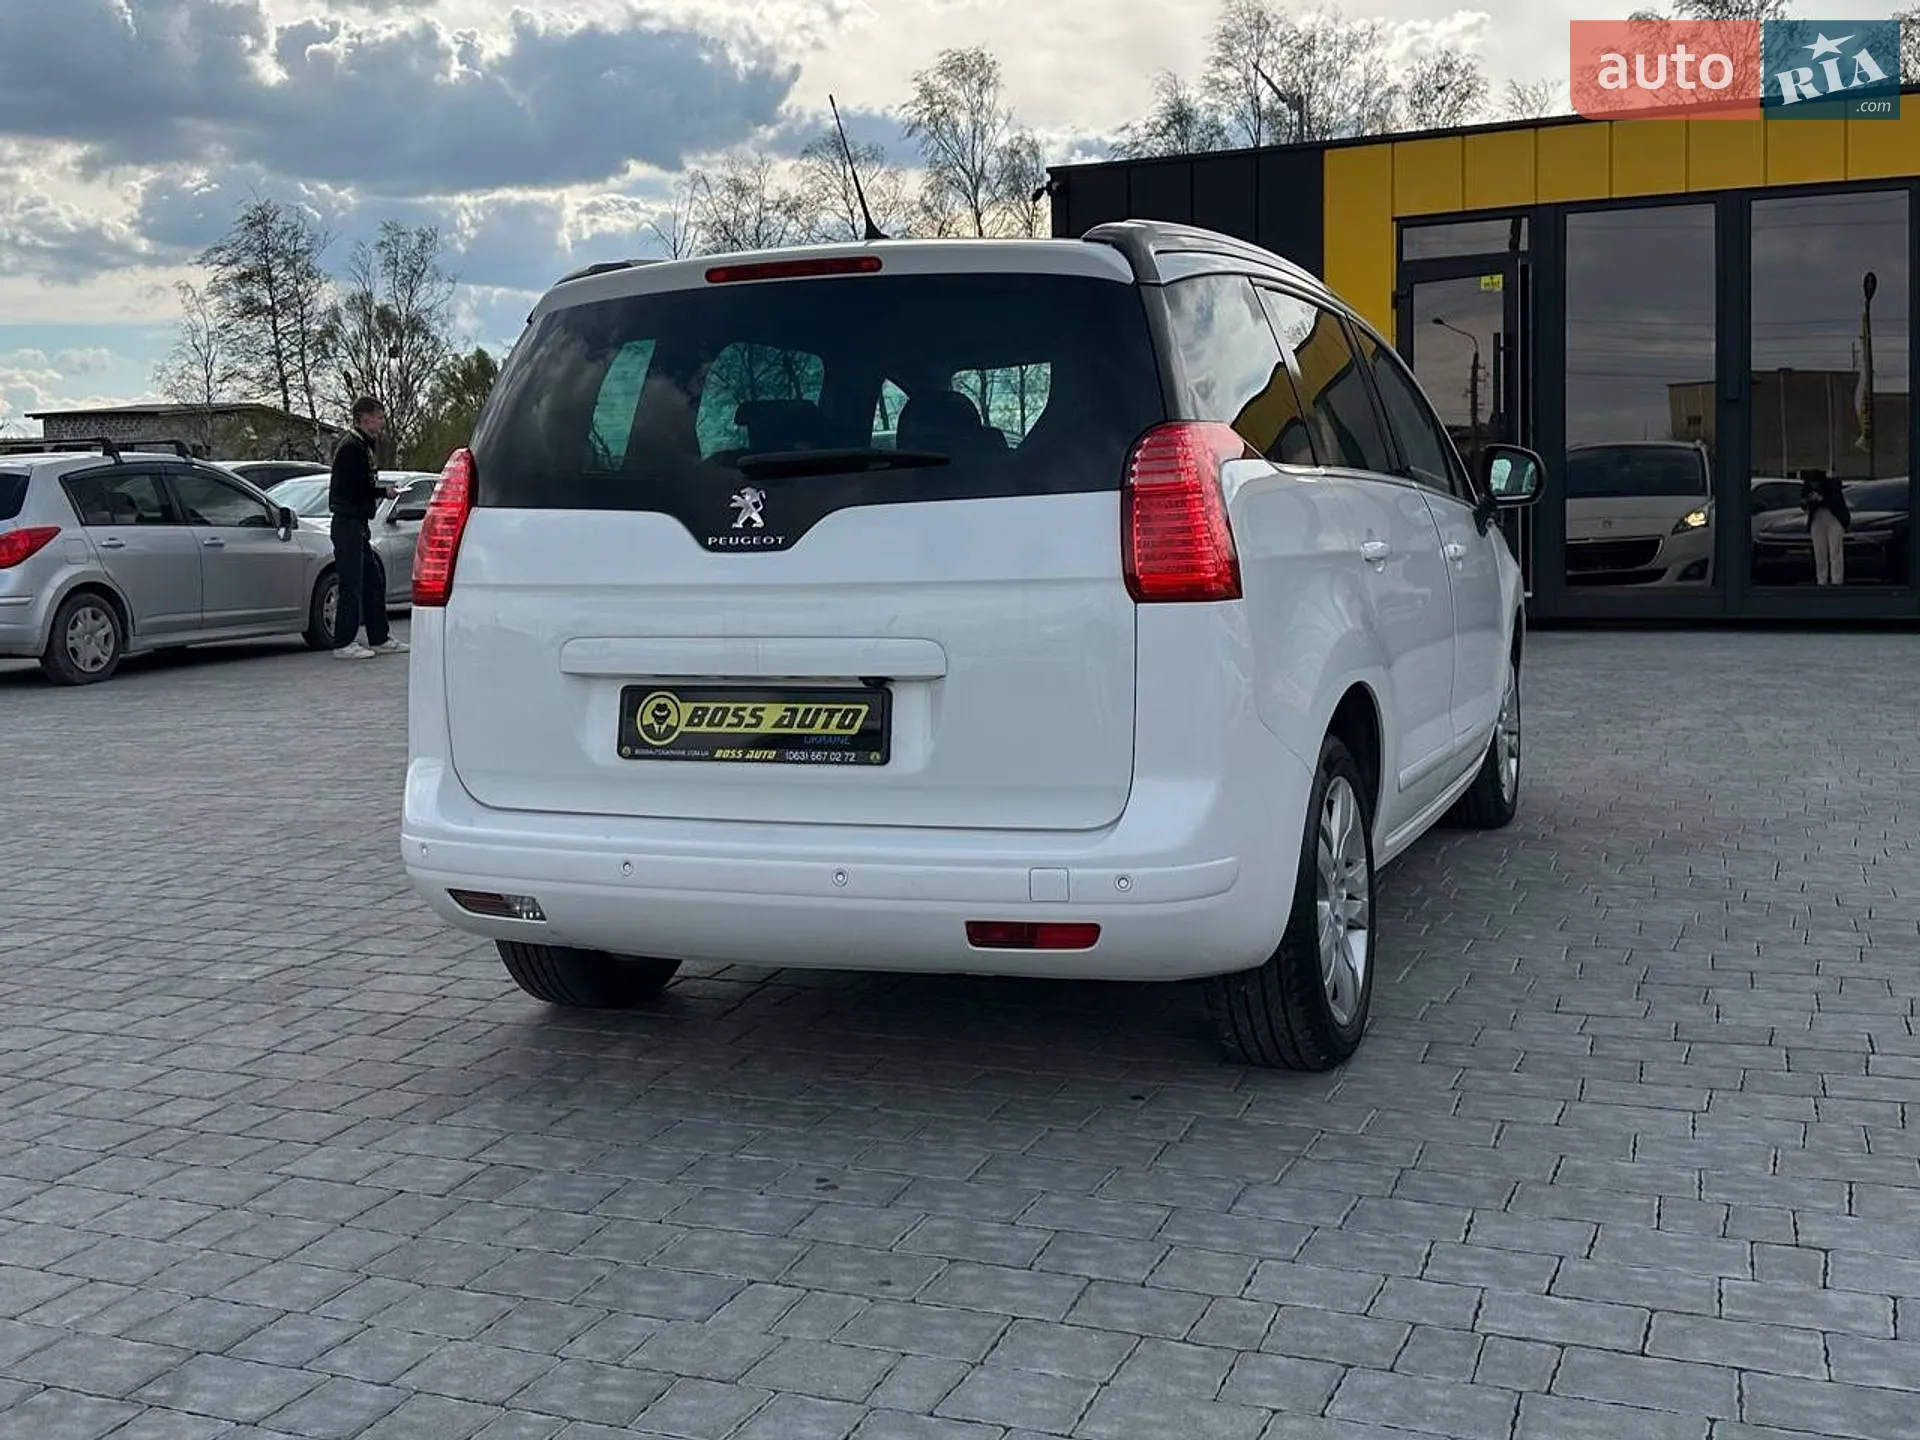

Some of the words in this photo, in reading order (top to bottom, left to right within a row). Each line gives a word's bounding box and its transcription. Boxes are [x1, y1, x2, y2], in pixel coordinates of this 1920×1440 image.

[708, 536, 785, 545] PEUGEOT
[685, 706, 766, 728] BOSS
[773, 708, 861, 729] AUTO
[714, 749, 743, 758] BOSS
[745, 749, 776, 759] AUTO
